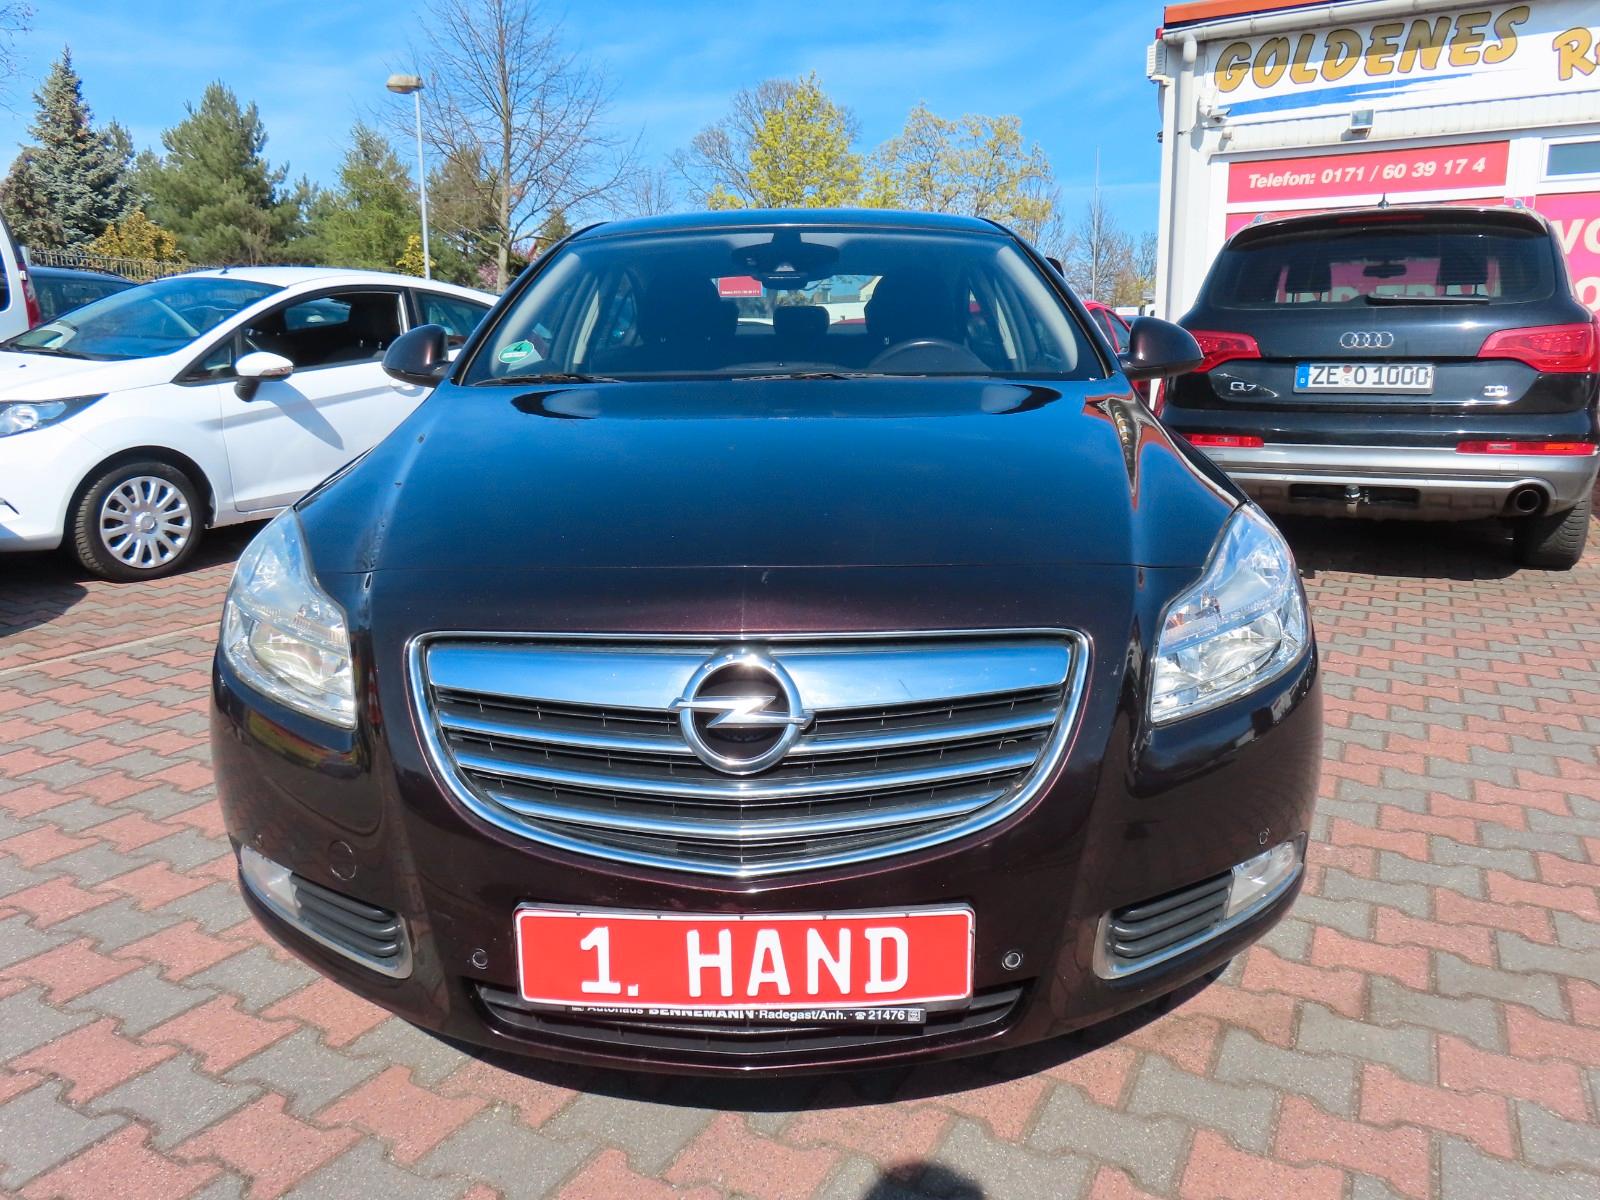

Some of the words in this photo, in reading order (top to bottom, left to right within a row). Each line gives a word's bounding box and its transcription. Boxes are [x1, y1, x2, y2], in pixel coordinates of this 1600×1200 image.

[1213, 5, 1530, 93] GOLDENES
[1552, 27, 1600, 81] R
[1249, 173, 1315, 188] Telefon:
[1321, 166, 1365, 184] 0171
[1369, 165, 1379, 182] /
[1382, 163, 1406, 180] 60
[1411, 160, 1437, 177] 39
[1443, 159, 1468, 175] 17
[1472, 157, 1486, 173] 4
[1230, 381, 1257, 392] Q7
[1312, 365, 1340, 385] ZE
[1372, 365, 1429, 385] 1000
[579, 926, 639, 997] 1.
[686, 926, 909, 998] HAND
[759, 1010, 846, 1021] Radegast/Anh.
[868, 1010, 905, 1020] 21476
